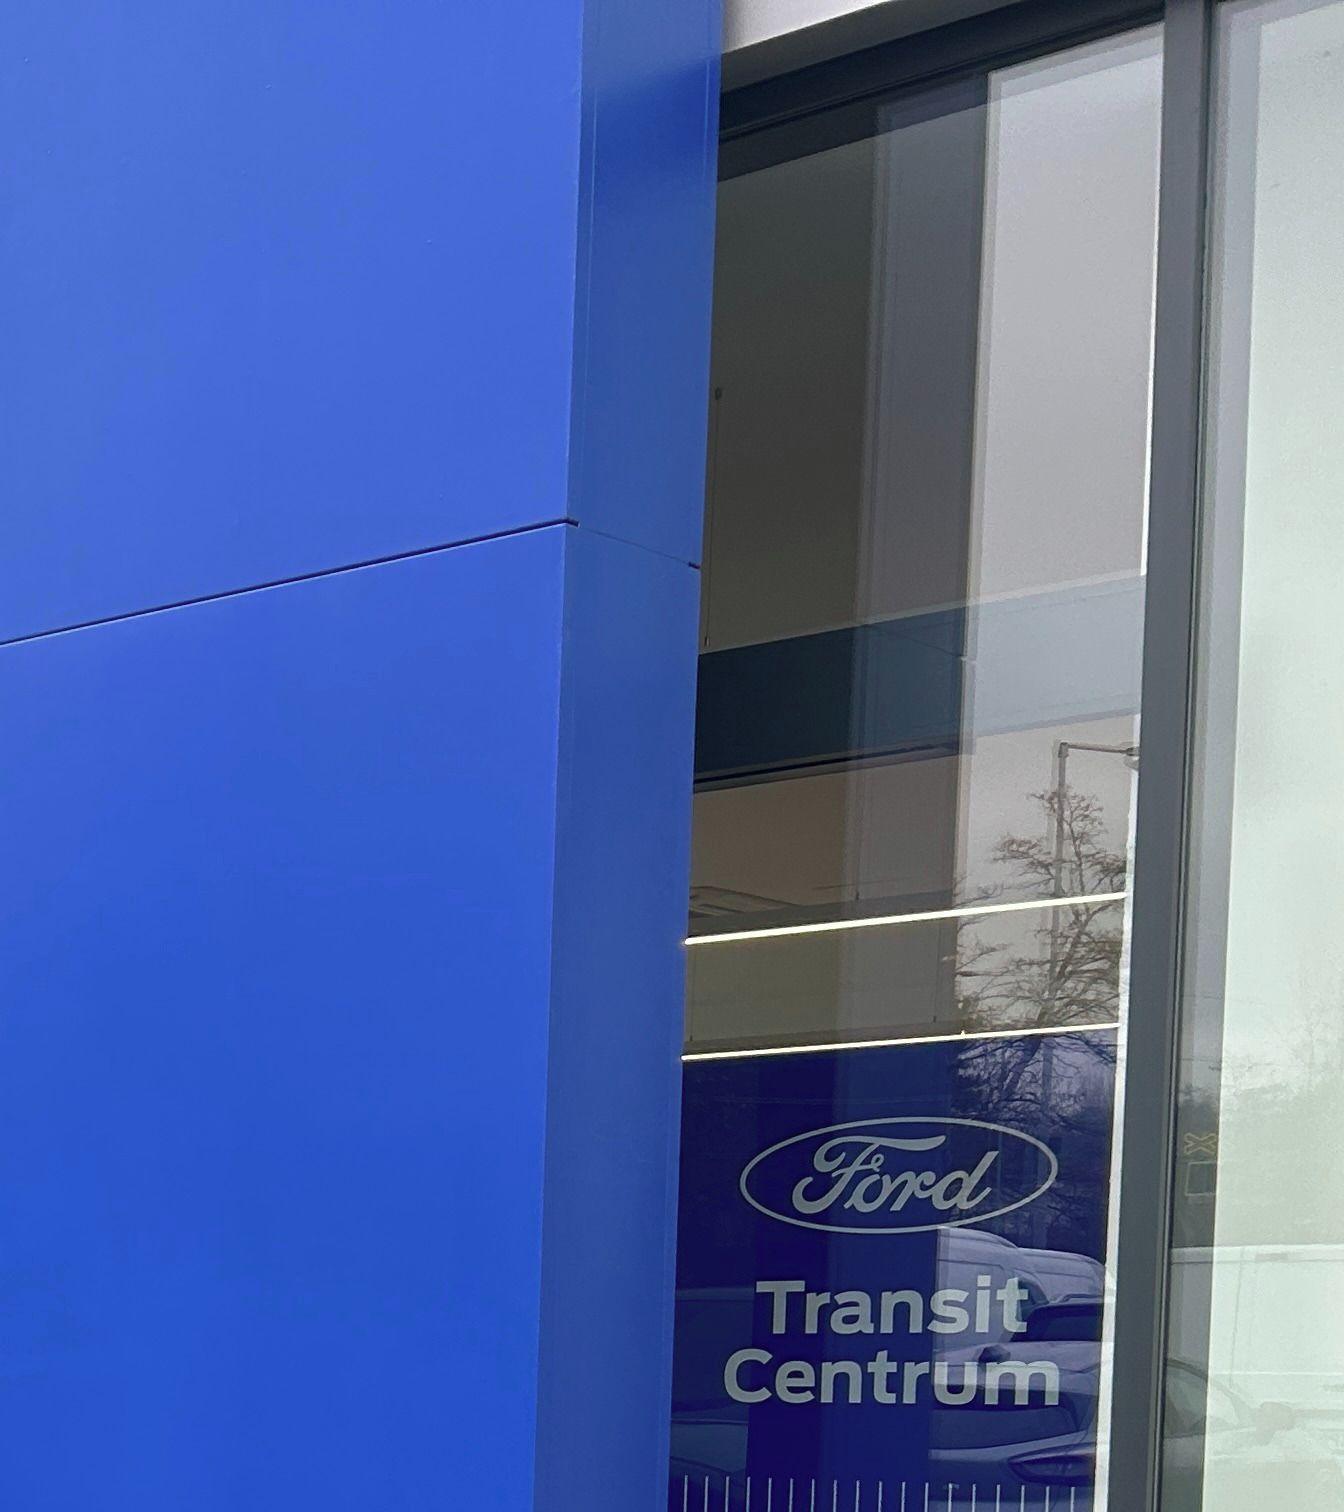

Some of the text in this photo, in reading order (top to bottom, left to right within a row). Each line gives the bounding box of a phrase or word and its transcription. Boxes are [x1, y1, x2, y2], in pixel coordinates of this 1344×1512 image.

[791, 1135, 1000, 1215] Ford
[755, 1274, 1029, 1335] Transit
[723, 1348, 1060, 1407] Centrum
